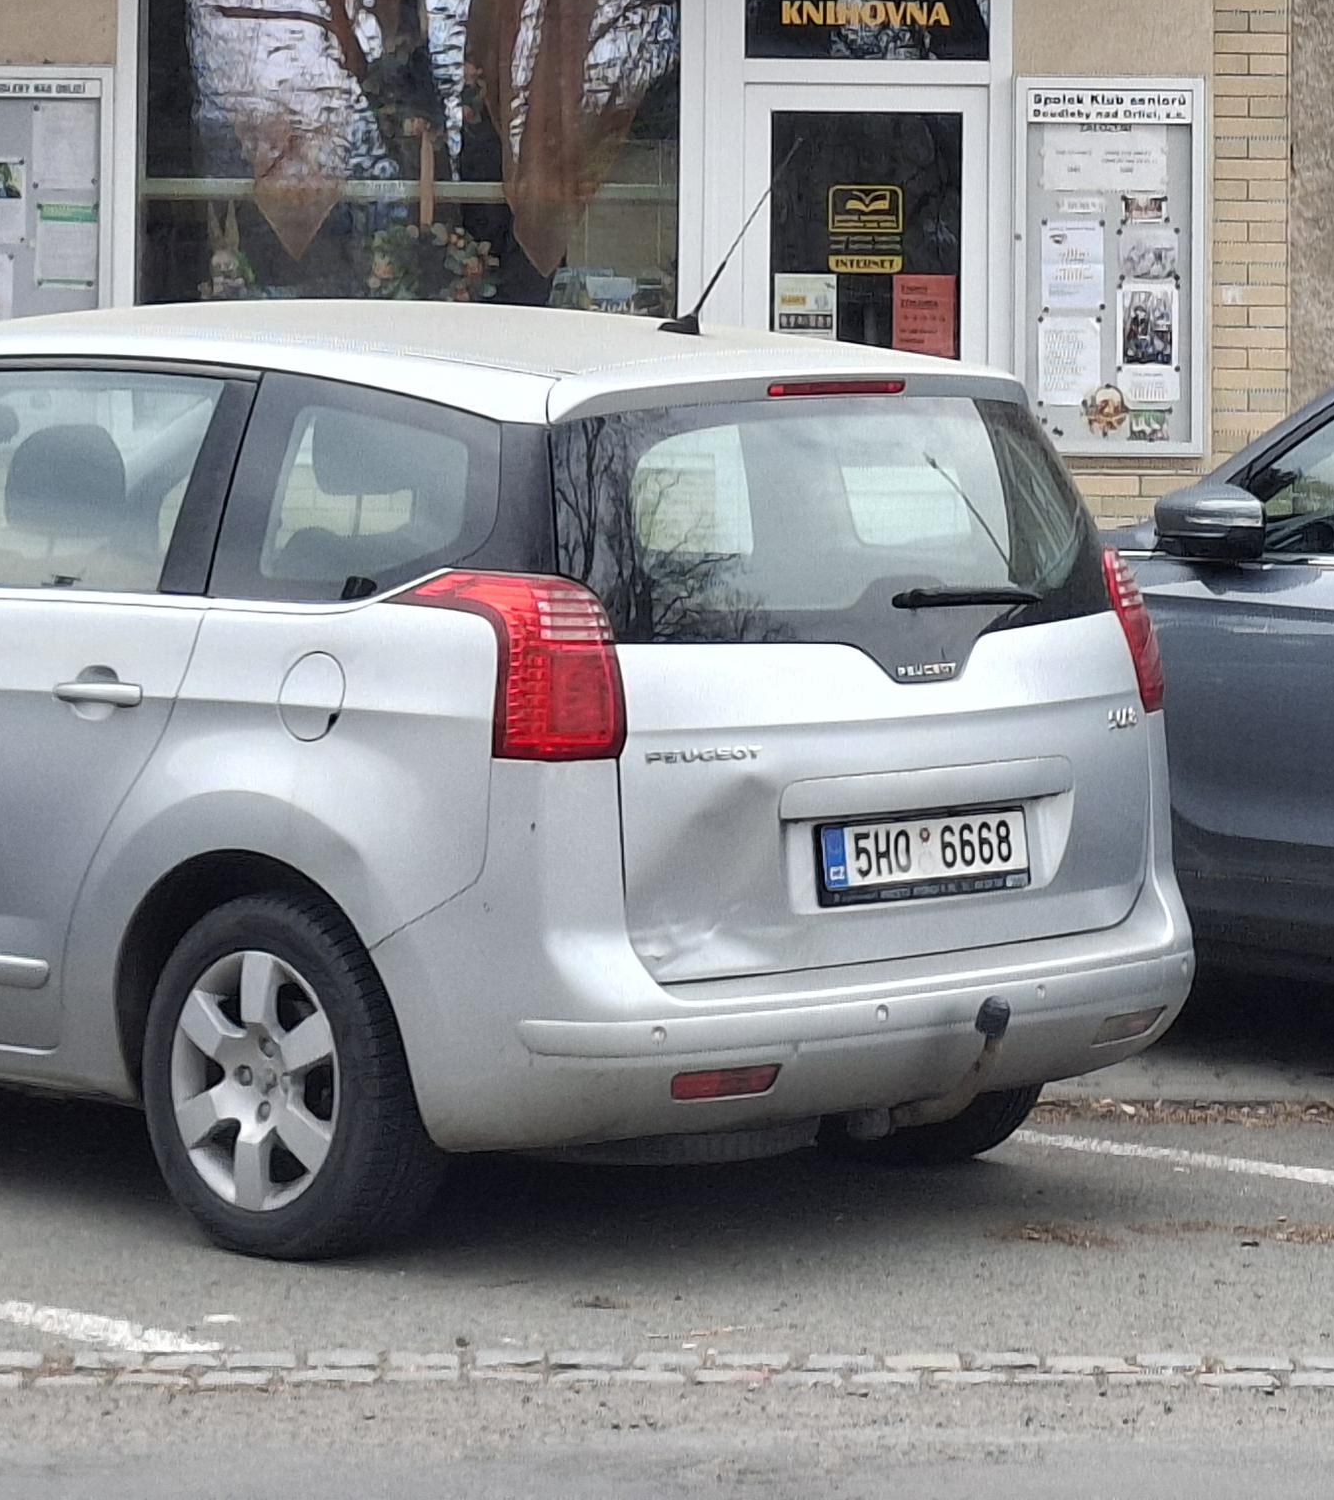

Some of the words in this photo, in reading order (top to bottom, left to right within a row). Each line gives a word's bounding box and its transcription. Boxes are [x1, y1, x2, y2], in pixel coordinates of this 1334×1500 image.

[781, 0, 951, 27] KNIHOVNA
[1033, 94, 1084, 107] Spolek
[1090, 94, 1124, 106] Klub
[1130, 94, 1187, 106] seniorů
[1033, 109, 1091, 120] Doudleby
[1095, 109, 1118, 119] nad
[835, 258, 895, 269] INTERNET
[645, 744, 763, 764] PEUGEOT
[940, 819, 1012, 869] 6668
